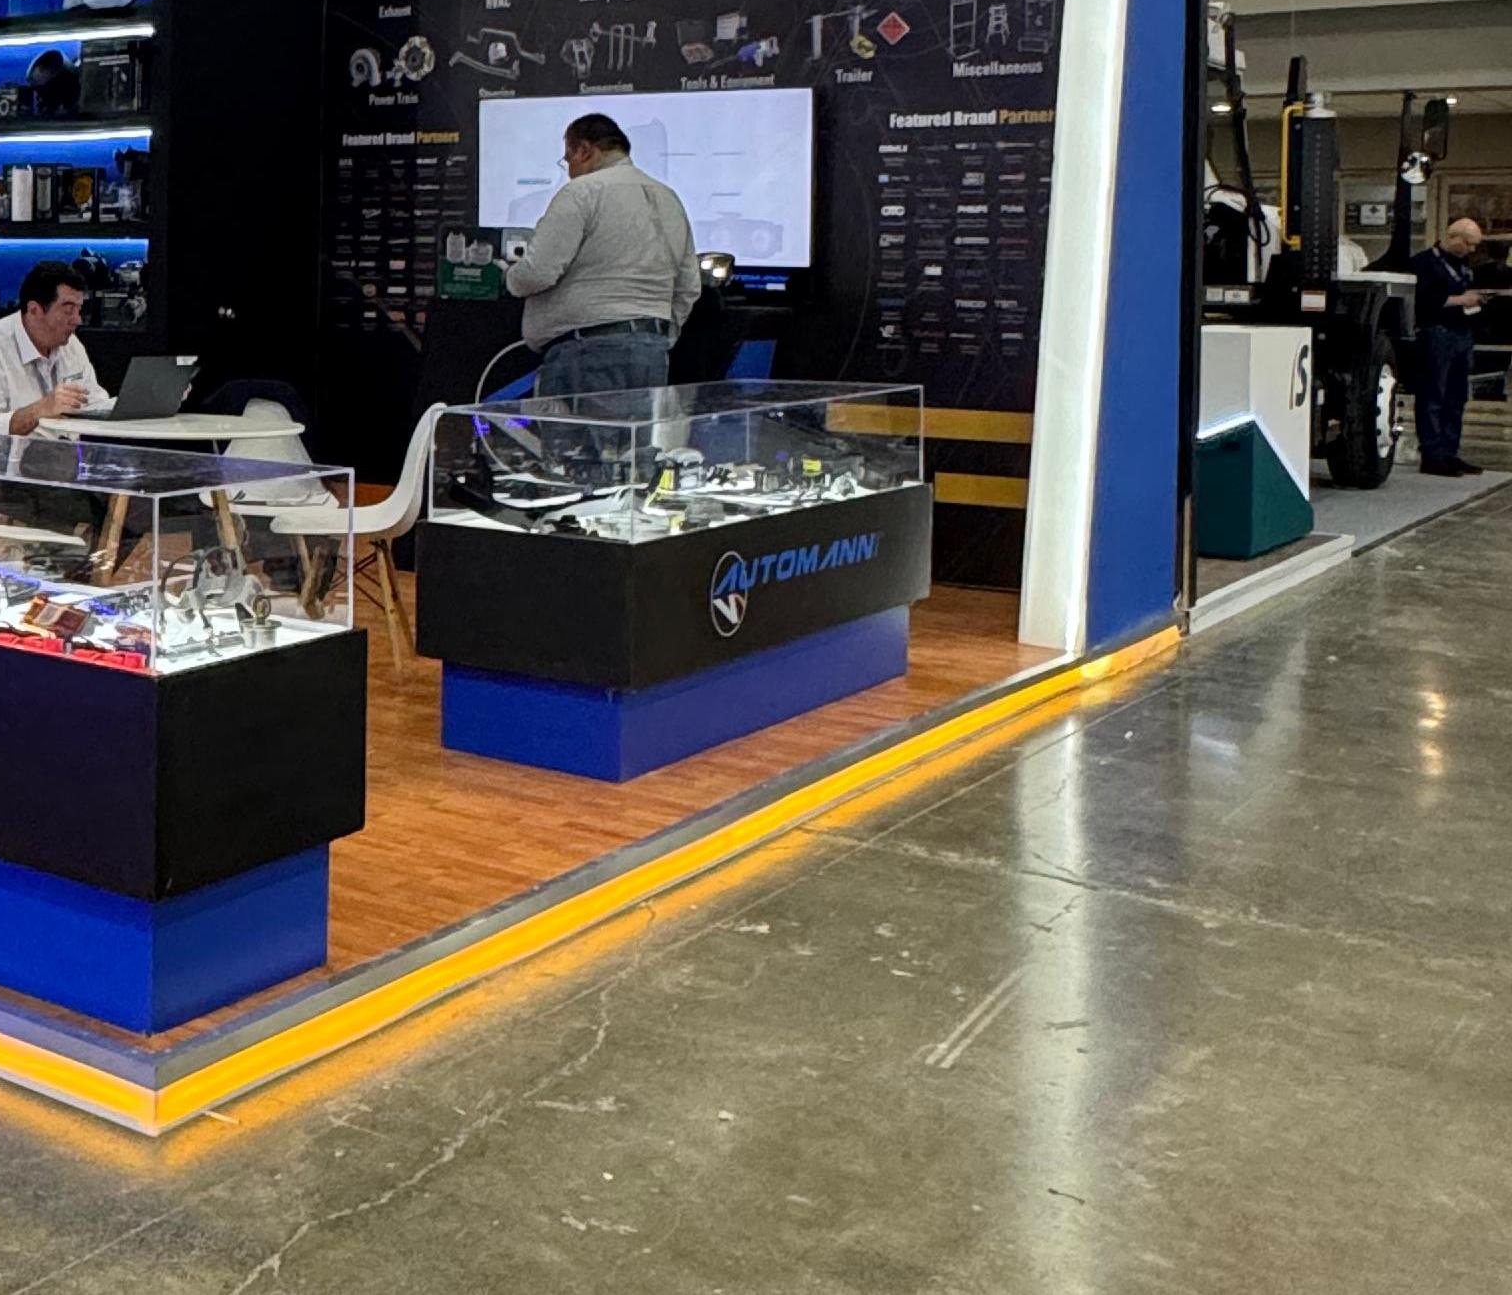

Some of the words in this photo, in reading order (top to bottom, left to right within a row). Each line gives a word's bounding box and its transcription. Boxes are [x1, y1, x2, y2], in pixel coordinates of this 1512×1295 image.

[835, 69, 873, 83] Trailer
[952, 60, 1044, 78] Miscellaneous
[890, 111, 951, 129] Featured
[954, 110, 996, 126] Brand
[999, 108, 1055, 125] Partner
[713, 532, 877, 596] AUTOMANN
